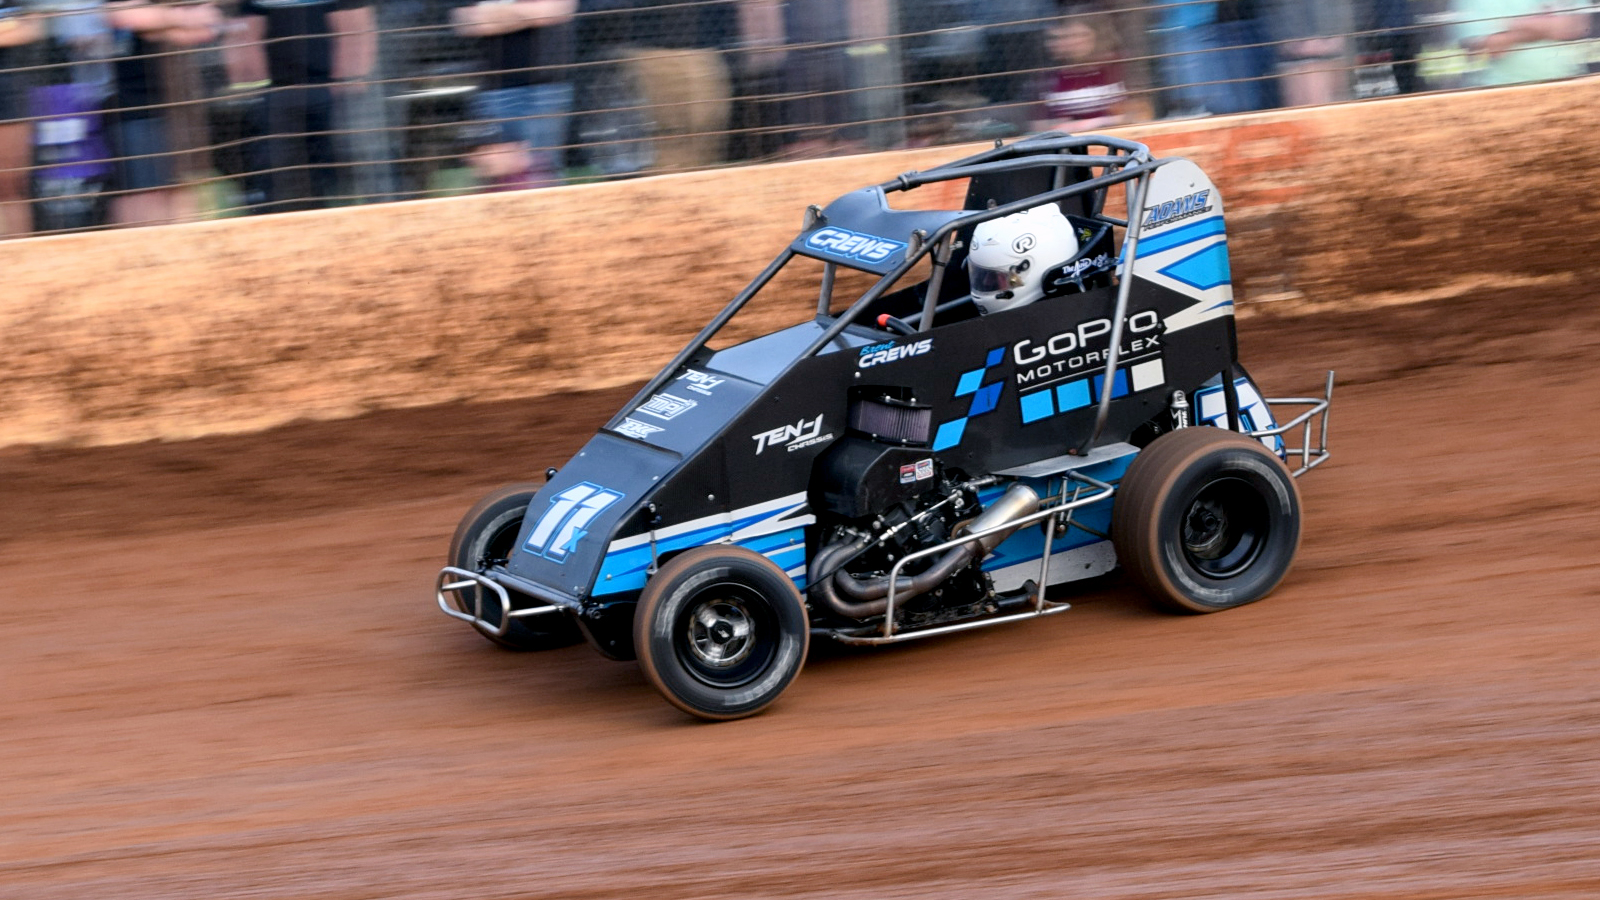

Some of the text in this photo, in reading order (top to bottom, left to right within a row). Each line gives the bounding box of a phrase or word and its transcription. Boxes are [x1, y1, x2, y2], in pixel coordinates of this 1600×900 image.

[1142, 189, 1210, 226] ADAMS
[808, 229, 900, 259] CREWS
[859, 340, 896, 356] Brent
[1013, 310, 1158, 365] GoPo
[858, 338, 933, 368] CREWS
[752, 413, 824, 456] TEN-J
[787, 432, 834, 453] CHASSIS
